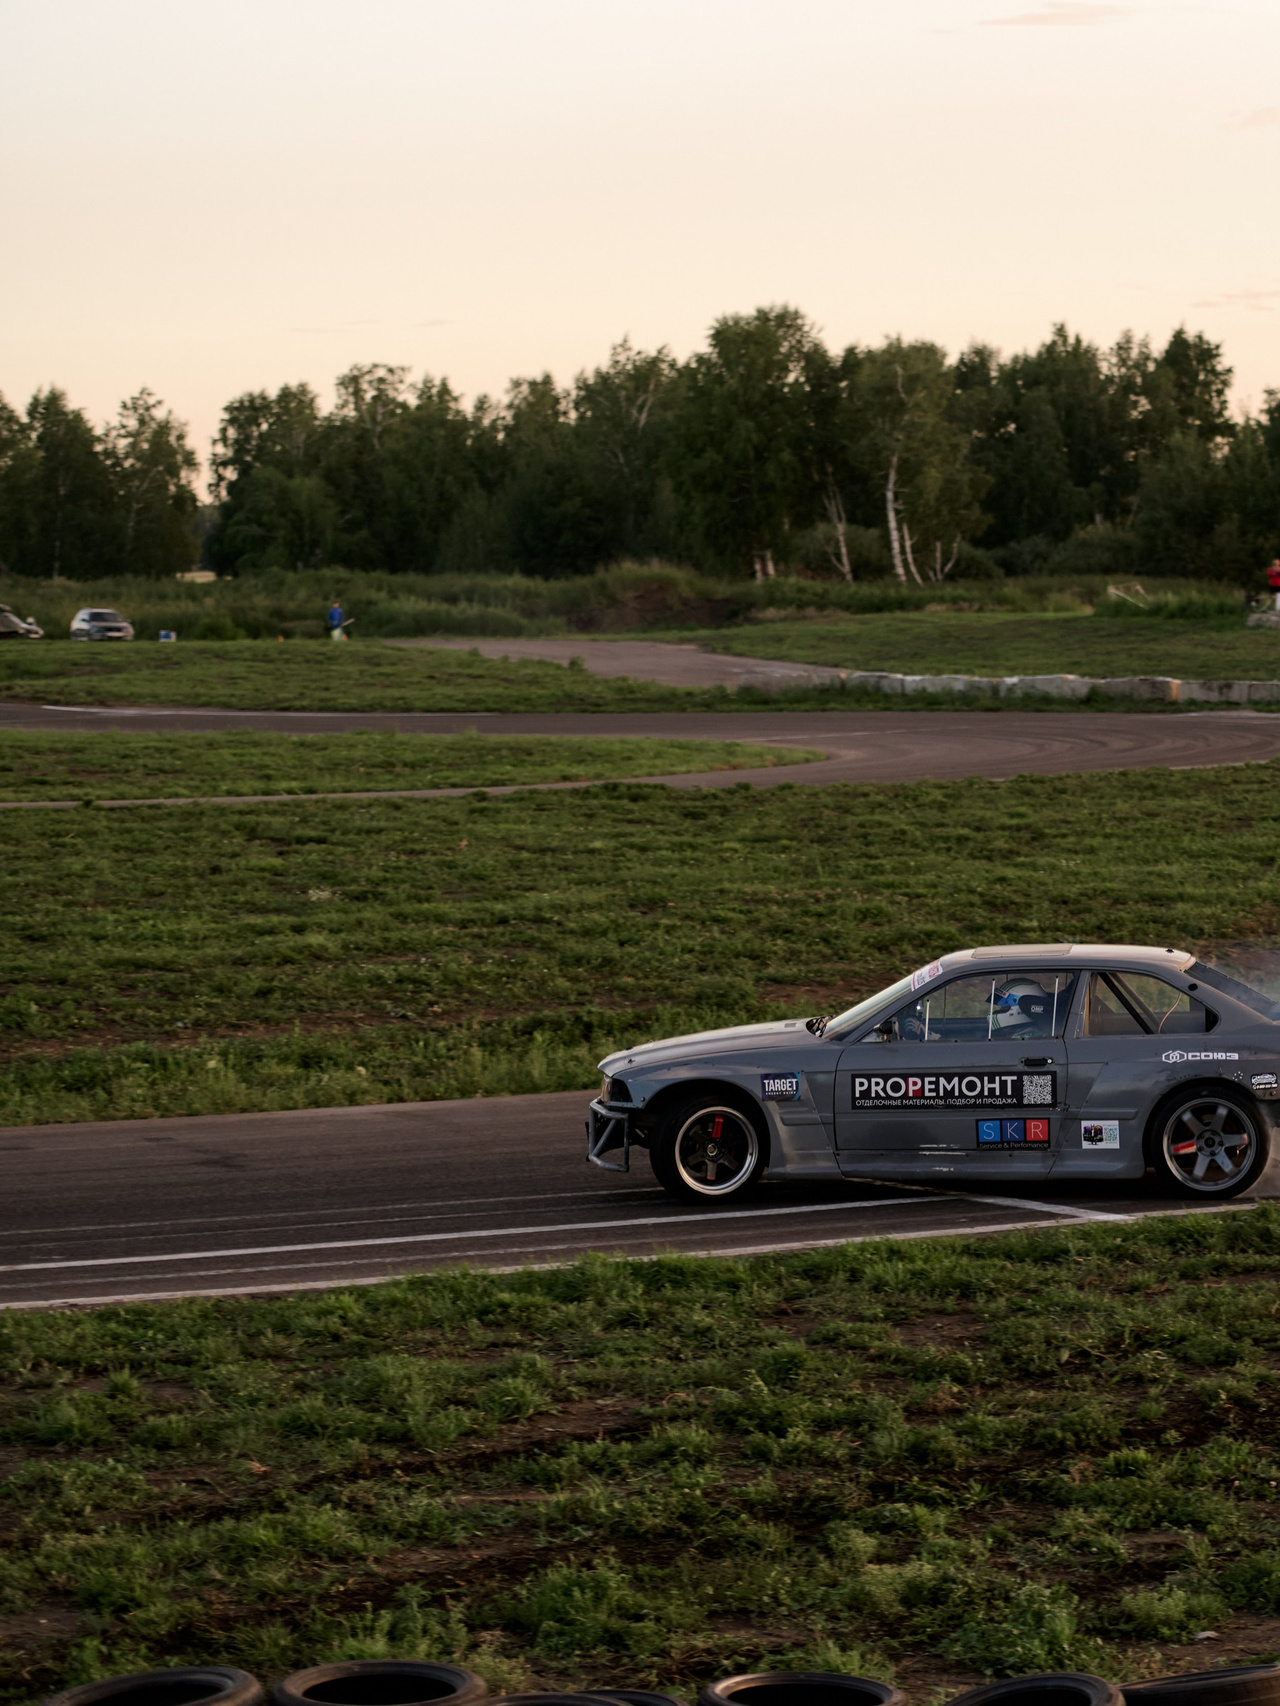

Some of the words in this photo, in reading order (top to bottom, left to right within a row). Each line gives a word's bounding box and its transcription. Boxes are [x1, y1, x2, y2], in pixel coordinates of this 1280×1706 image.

[1187, 1052, 1239, 1061] СОЮЗ
[763, 1078, 798, 1092] TARGET
[855, 1099, 902, 1107] ОТДЕЛОЧНЫЕ
[946, 1098, 975, 1106] ПОДБОР
[983, 1097, 1018, 1105] ПРОДАЖА
[983, 1121, 1043, 1140] SKR
